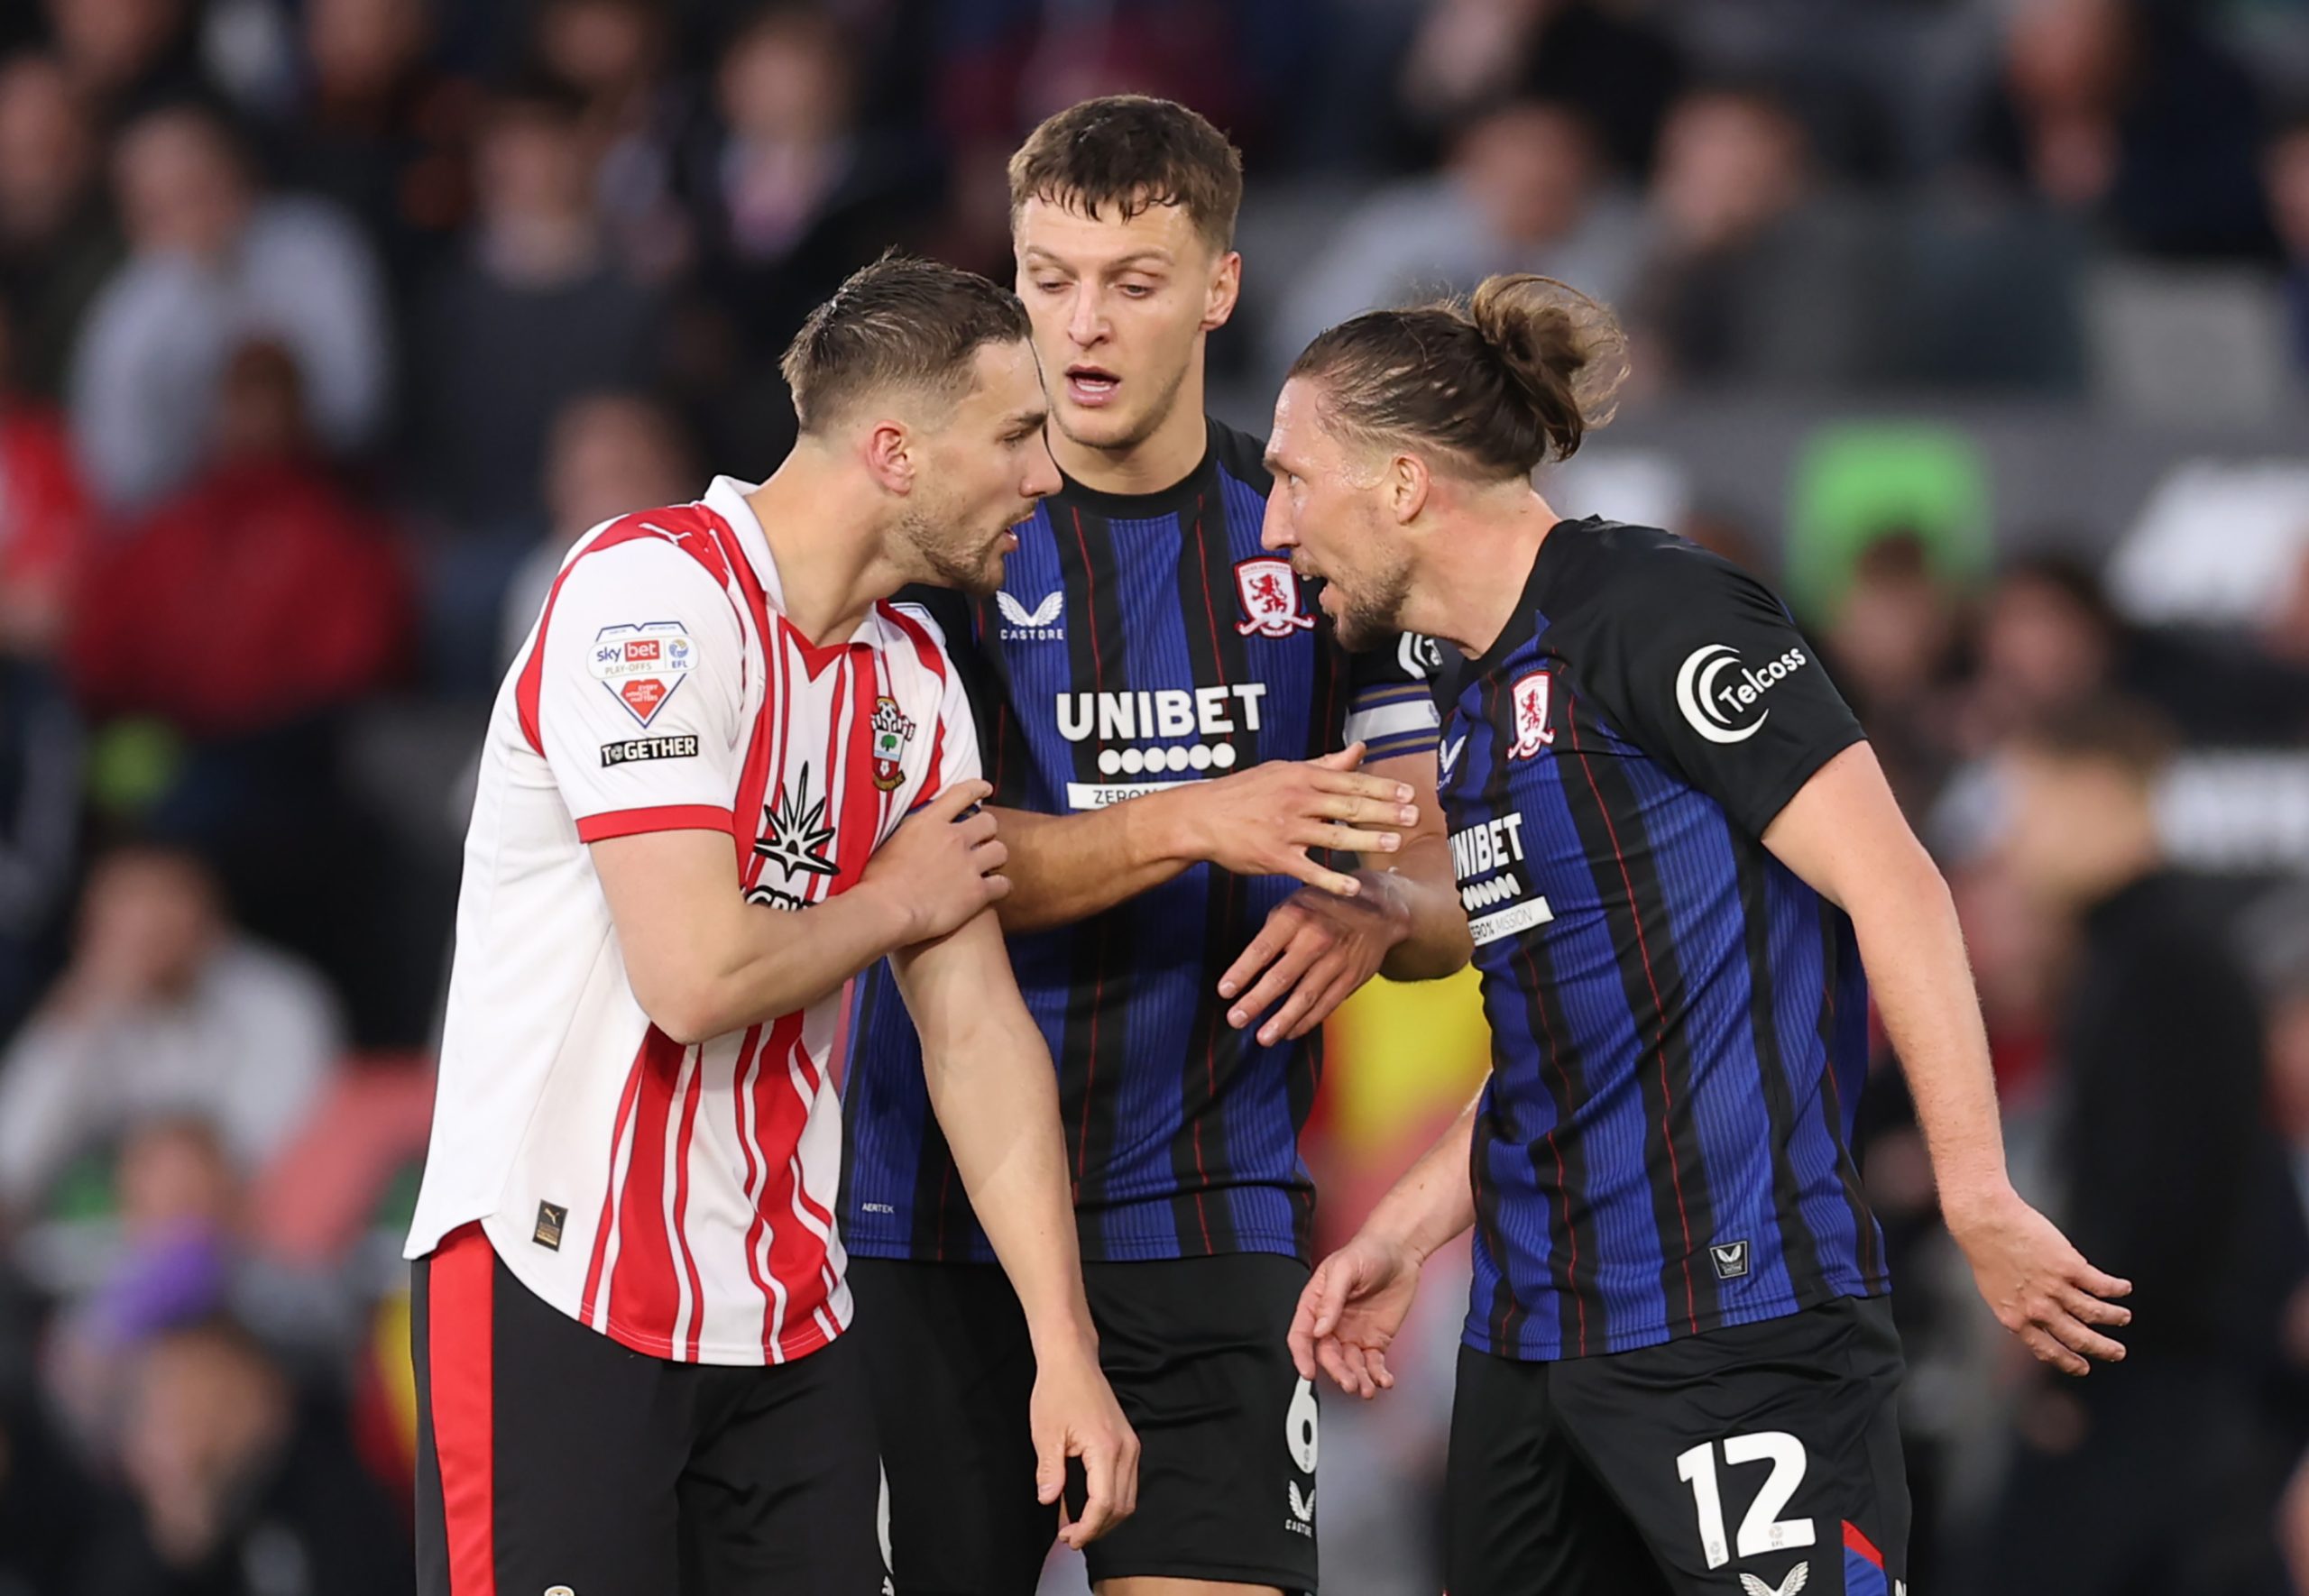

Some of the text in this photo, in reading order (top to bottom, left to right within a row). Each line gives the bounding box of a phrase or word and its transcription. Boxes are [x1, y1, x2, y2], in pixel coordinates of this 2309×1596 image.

[999, 628, 1064, 640] CASTORE
[596, 642, 658, 663] sky bet
[671, 660, 688, 669] EFL
[605, 664, 652, 675] PLAY-OFFS
[1717, 647, 1807, 713] Telcoss
[1056, 683, 1267, 742] UNIBET
[1469, 907, 1533, 940] ERO% MISSION
[1285, 1374, 1319, 1474] 6
[1676, 1431, 1817, 1570] 12
